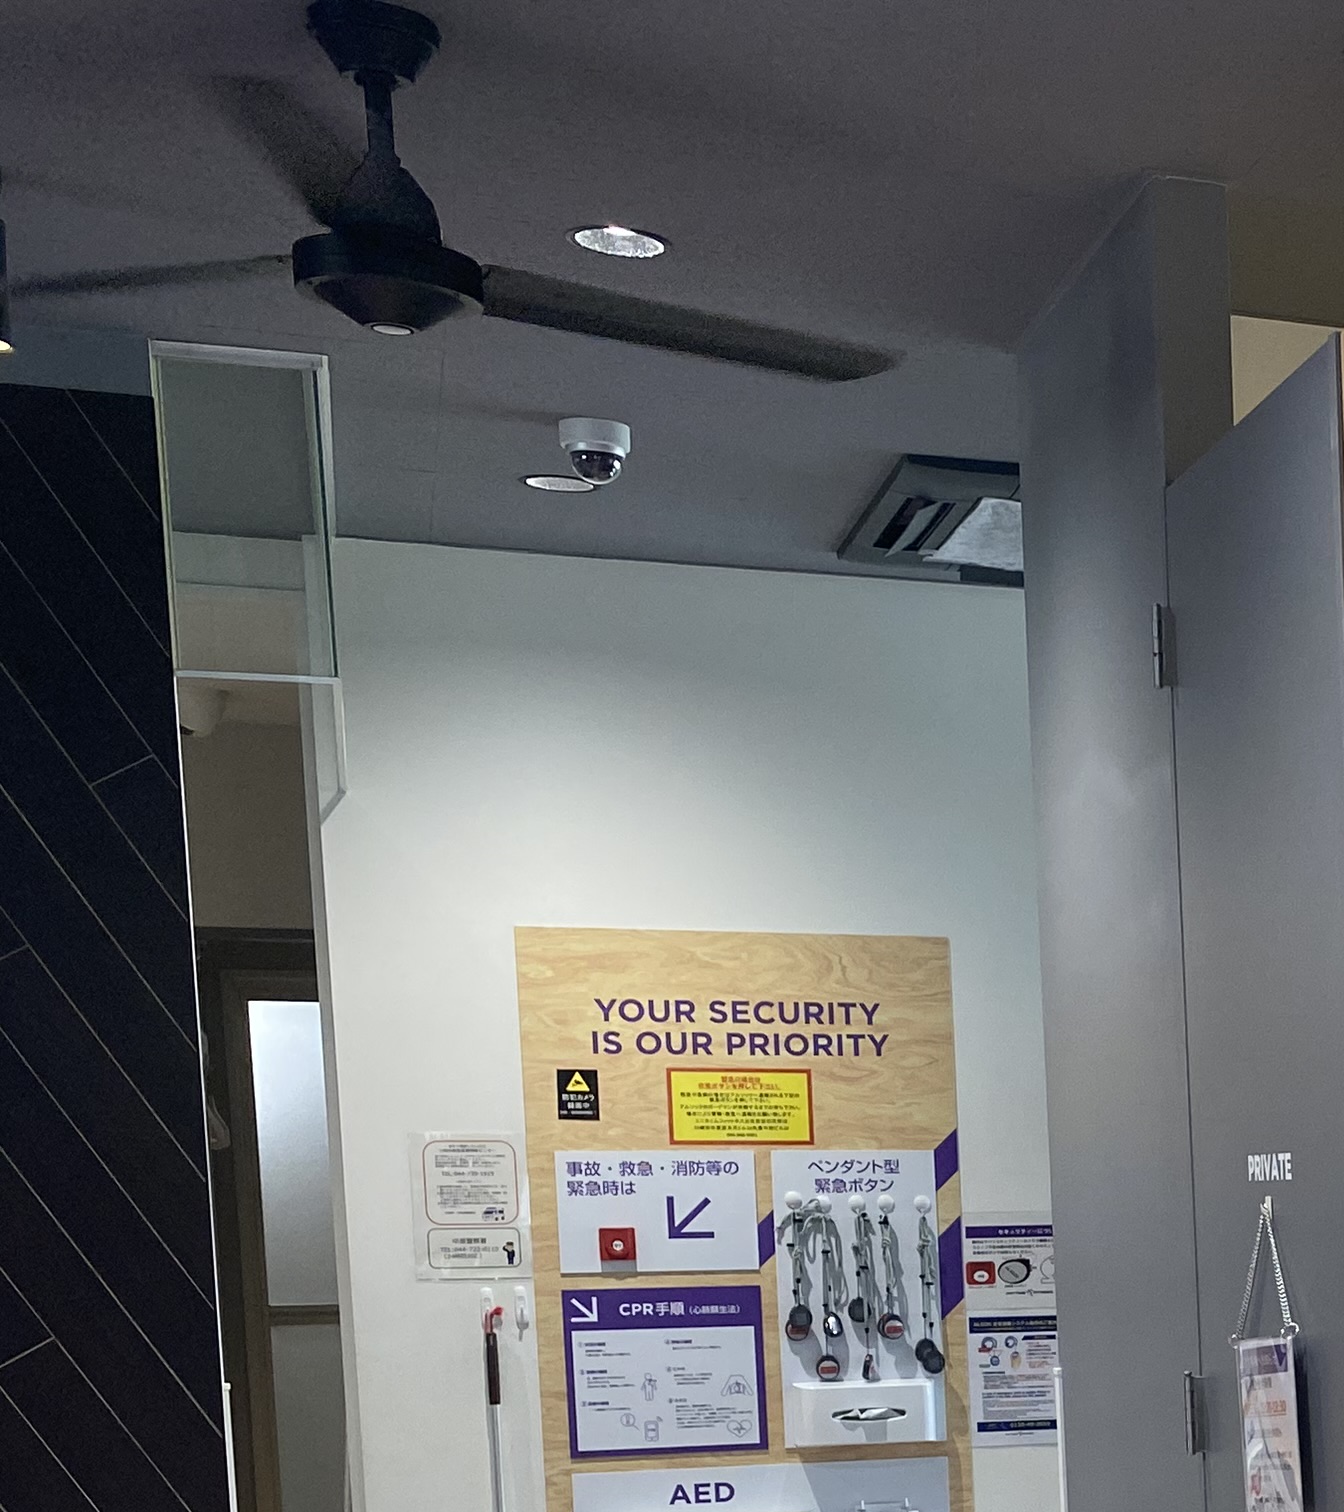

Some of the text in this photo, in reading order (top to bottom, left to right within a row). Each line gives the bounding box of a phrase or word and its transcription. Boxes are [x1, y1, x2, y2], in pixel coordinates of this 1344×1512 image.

[594, 998, 880, 1026] YOUR SECURITY
[592, 1030, 889, 1057] IS OUR PRIORITY
[566, 1160, 740, 1177] 事故・救急・消防等の
[808, 1158, 901, 1175] ペンダント型
[1248, 1152, 1293, 1182] PRIVATE
[567, 1180, 637, 1197] 緊急時は
[814, 1178, 895, 1195] 緊急ボタン
[669, 1482, 736, 1506] AED
